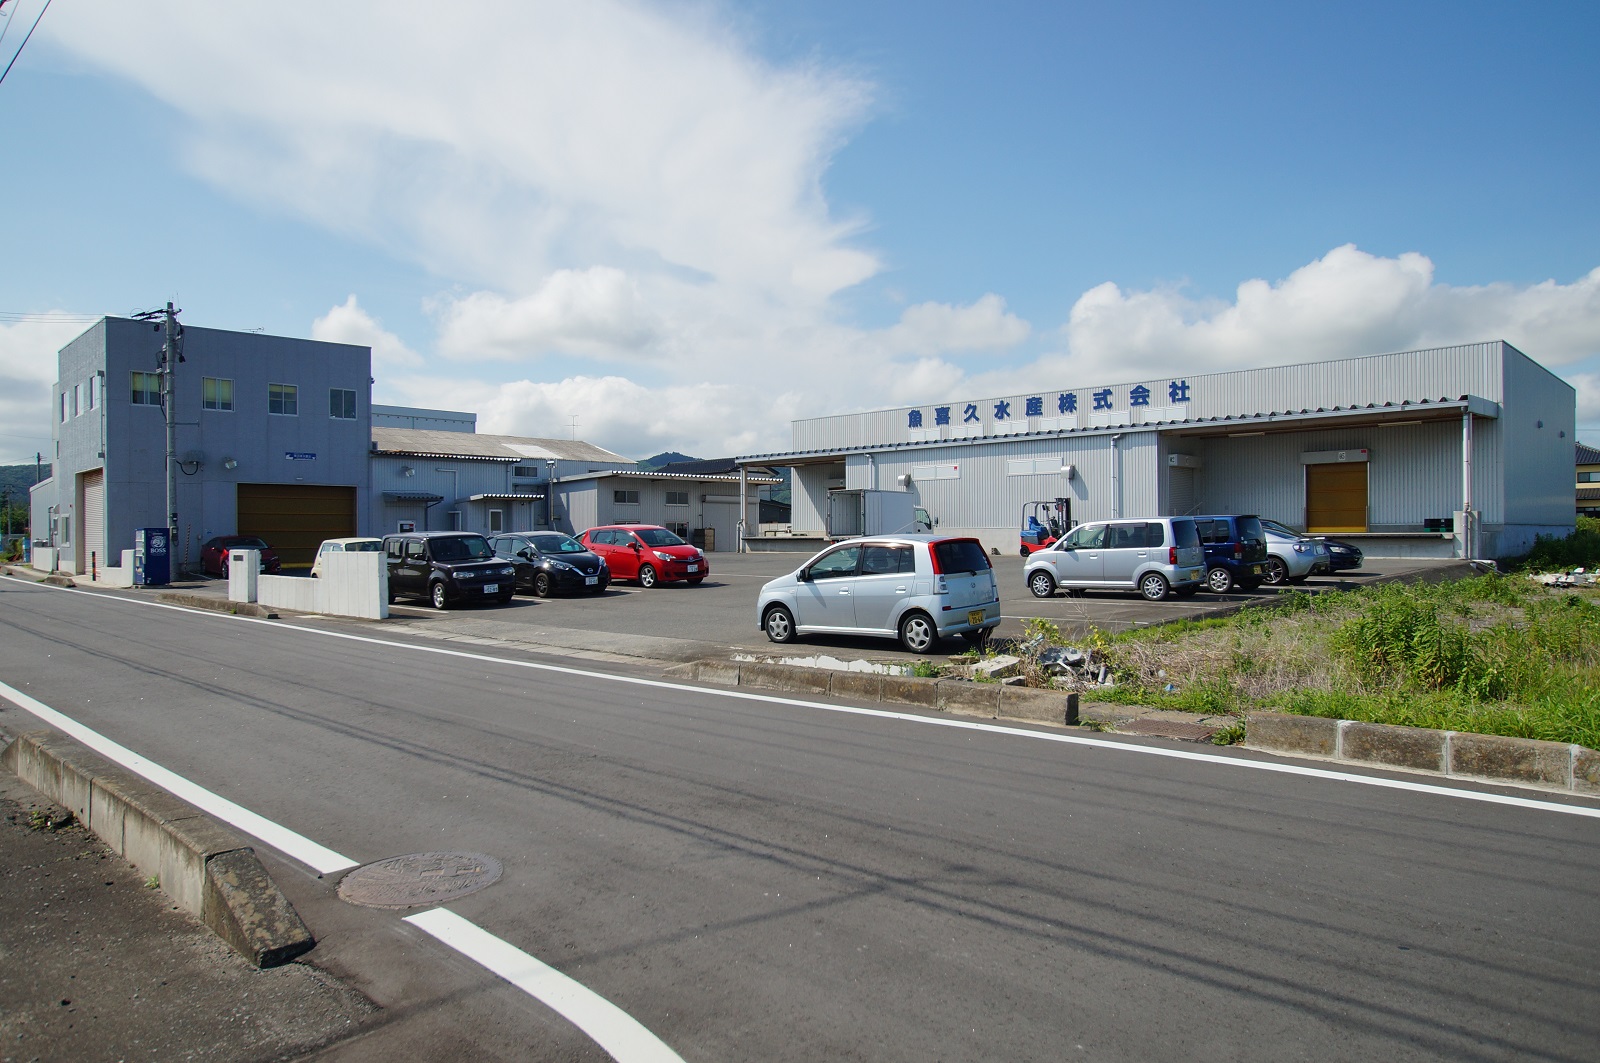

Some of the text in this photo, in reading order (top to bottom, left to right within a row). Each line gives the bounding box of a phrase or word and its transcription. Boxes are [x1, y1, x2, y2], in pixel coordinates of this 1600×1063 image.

[908, 380, 1190, 428] 魚喜久水産株式会社
